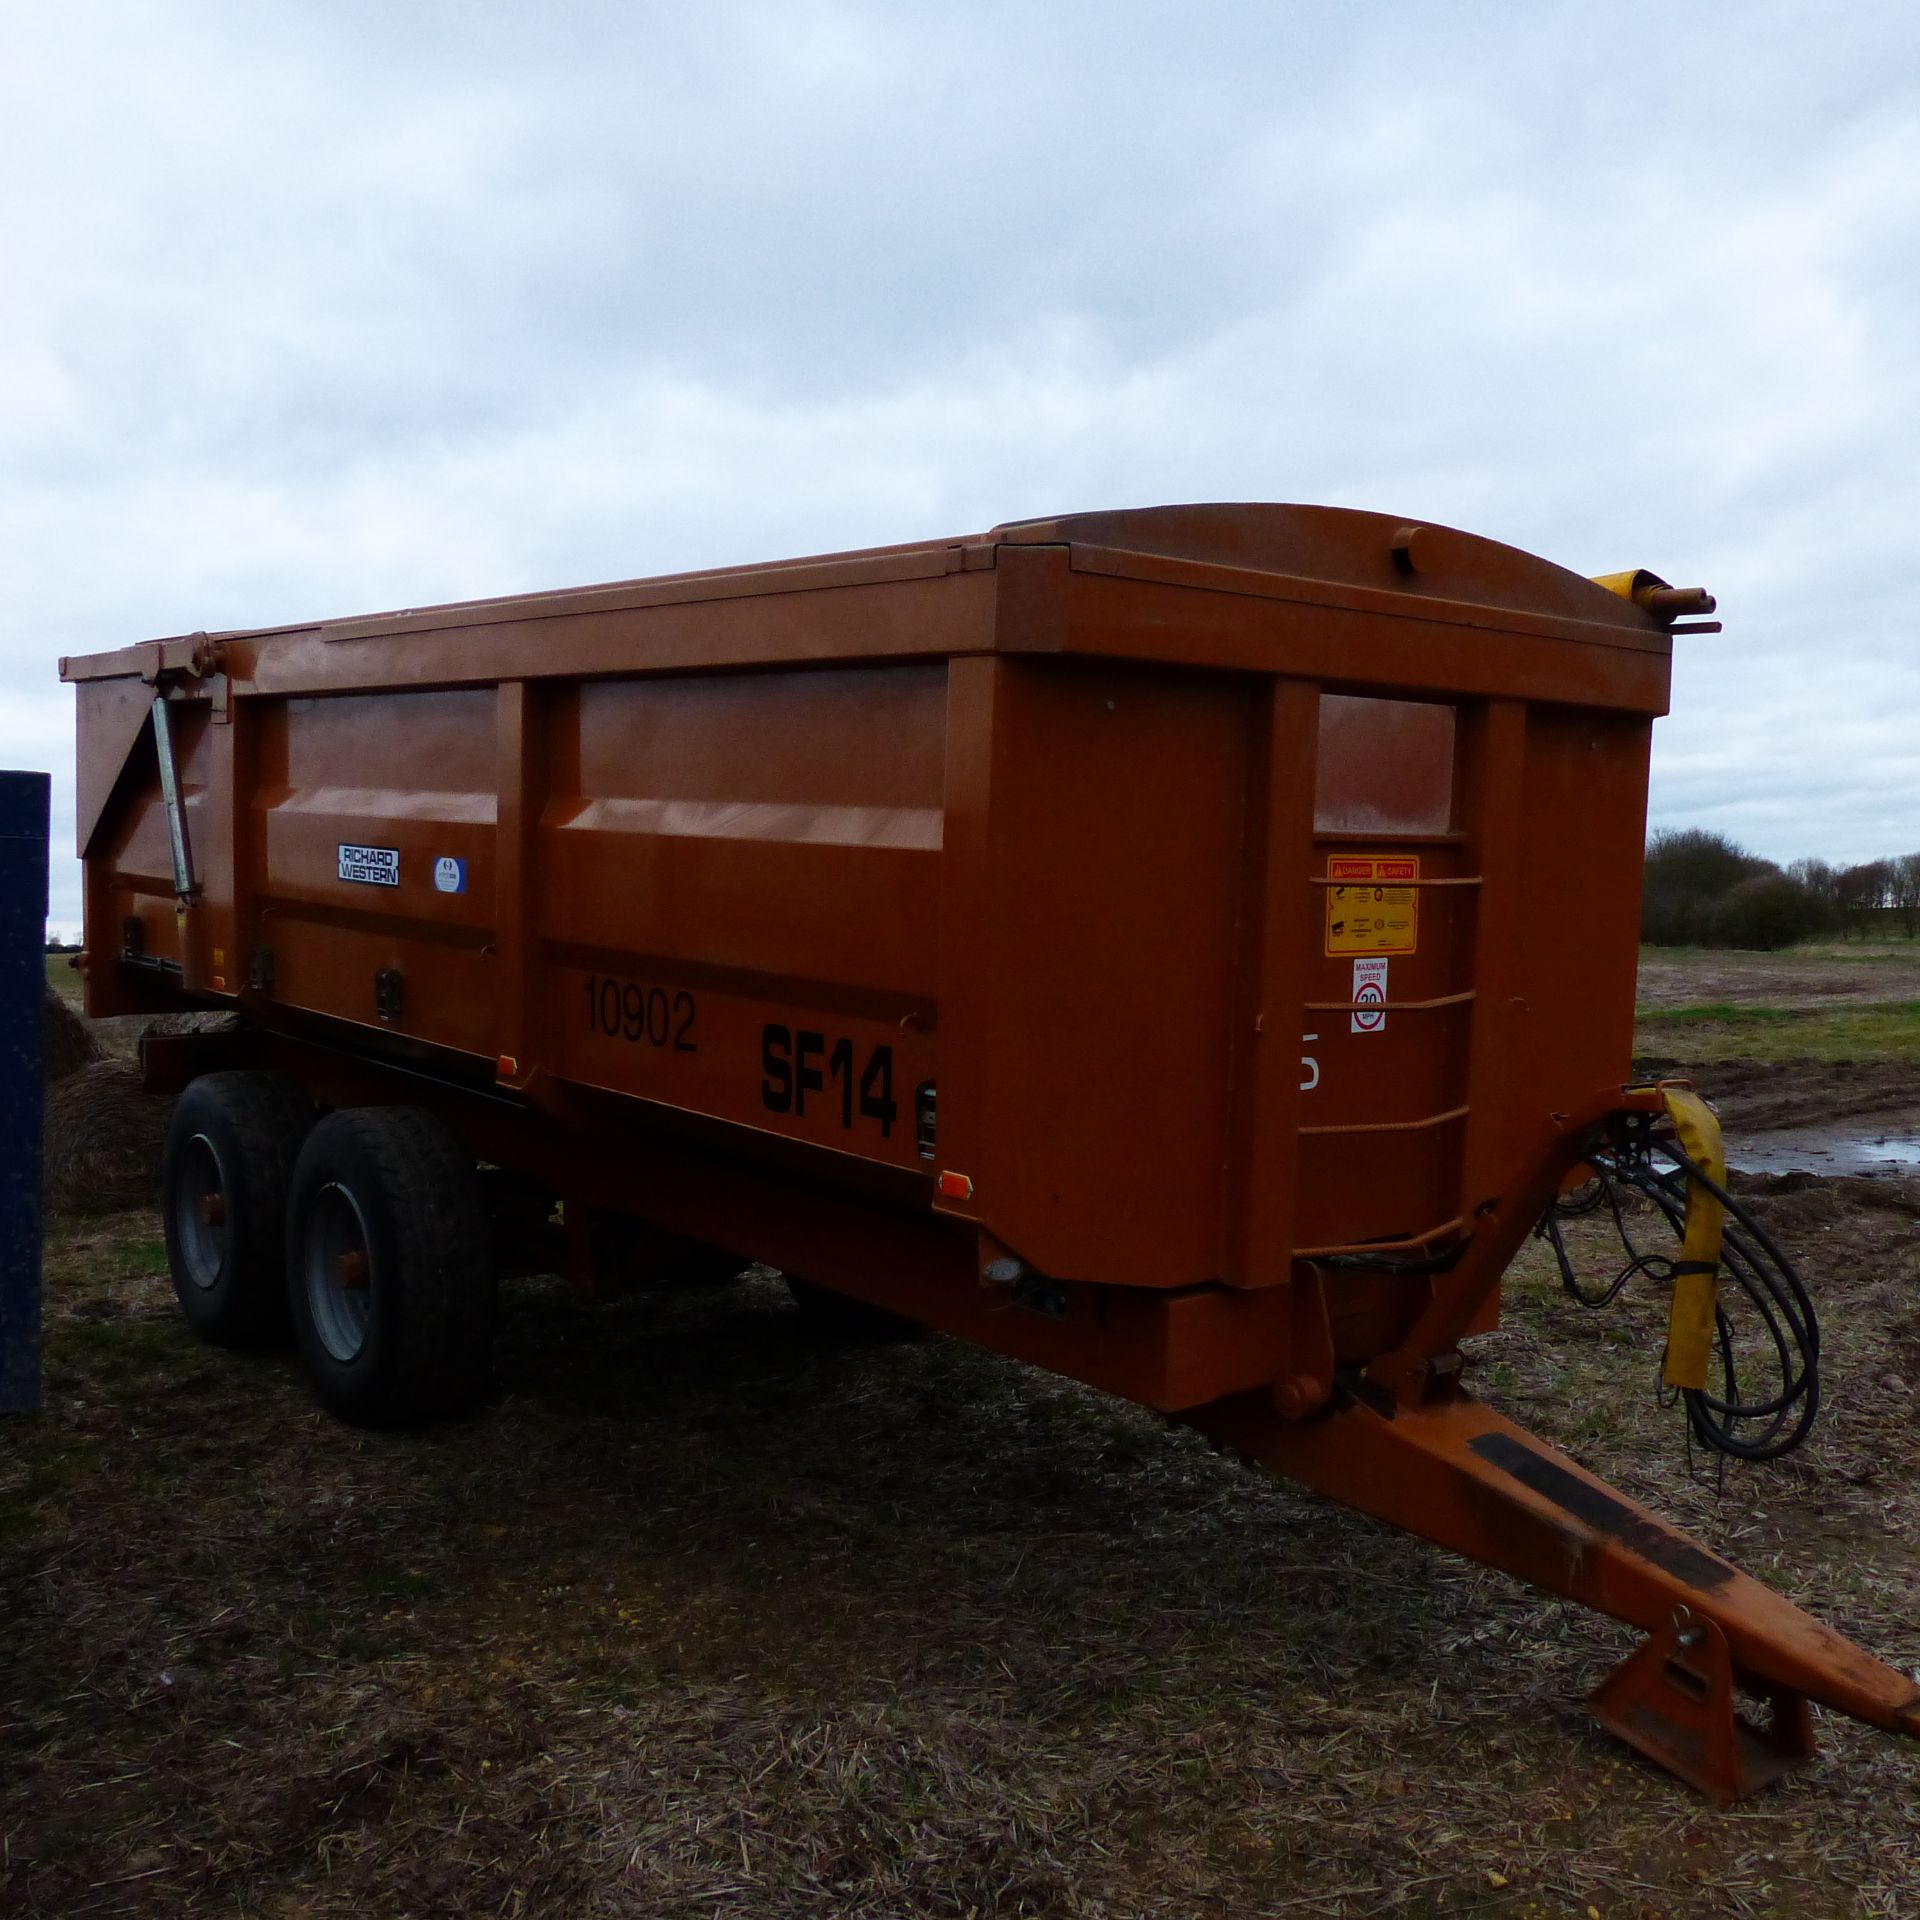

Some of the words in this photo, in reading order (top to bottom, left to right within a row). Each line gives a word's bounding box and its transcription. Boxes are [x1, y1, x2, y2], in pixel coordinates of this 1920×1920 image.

[344, 848, 393, 867] RICHARD
[341, 863, 396, 883] WESTERN
[1342, 866, 1371, 875] DANGER
[1387, 866, 1412, 876] SAFETY
[1356, 962, 1386, 972] MAXIMUM
[1360, 973, 1381, 982] SPEED
[585, 975, 697, 1052] 10902
[1363, 1012, 1375, 1020] MPH
[762, 1024, 897, 1139] SF14
